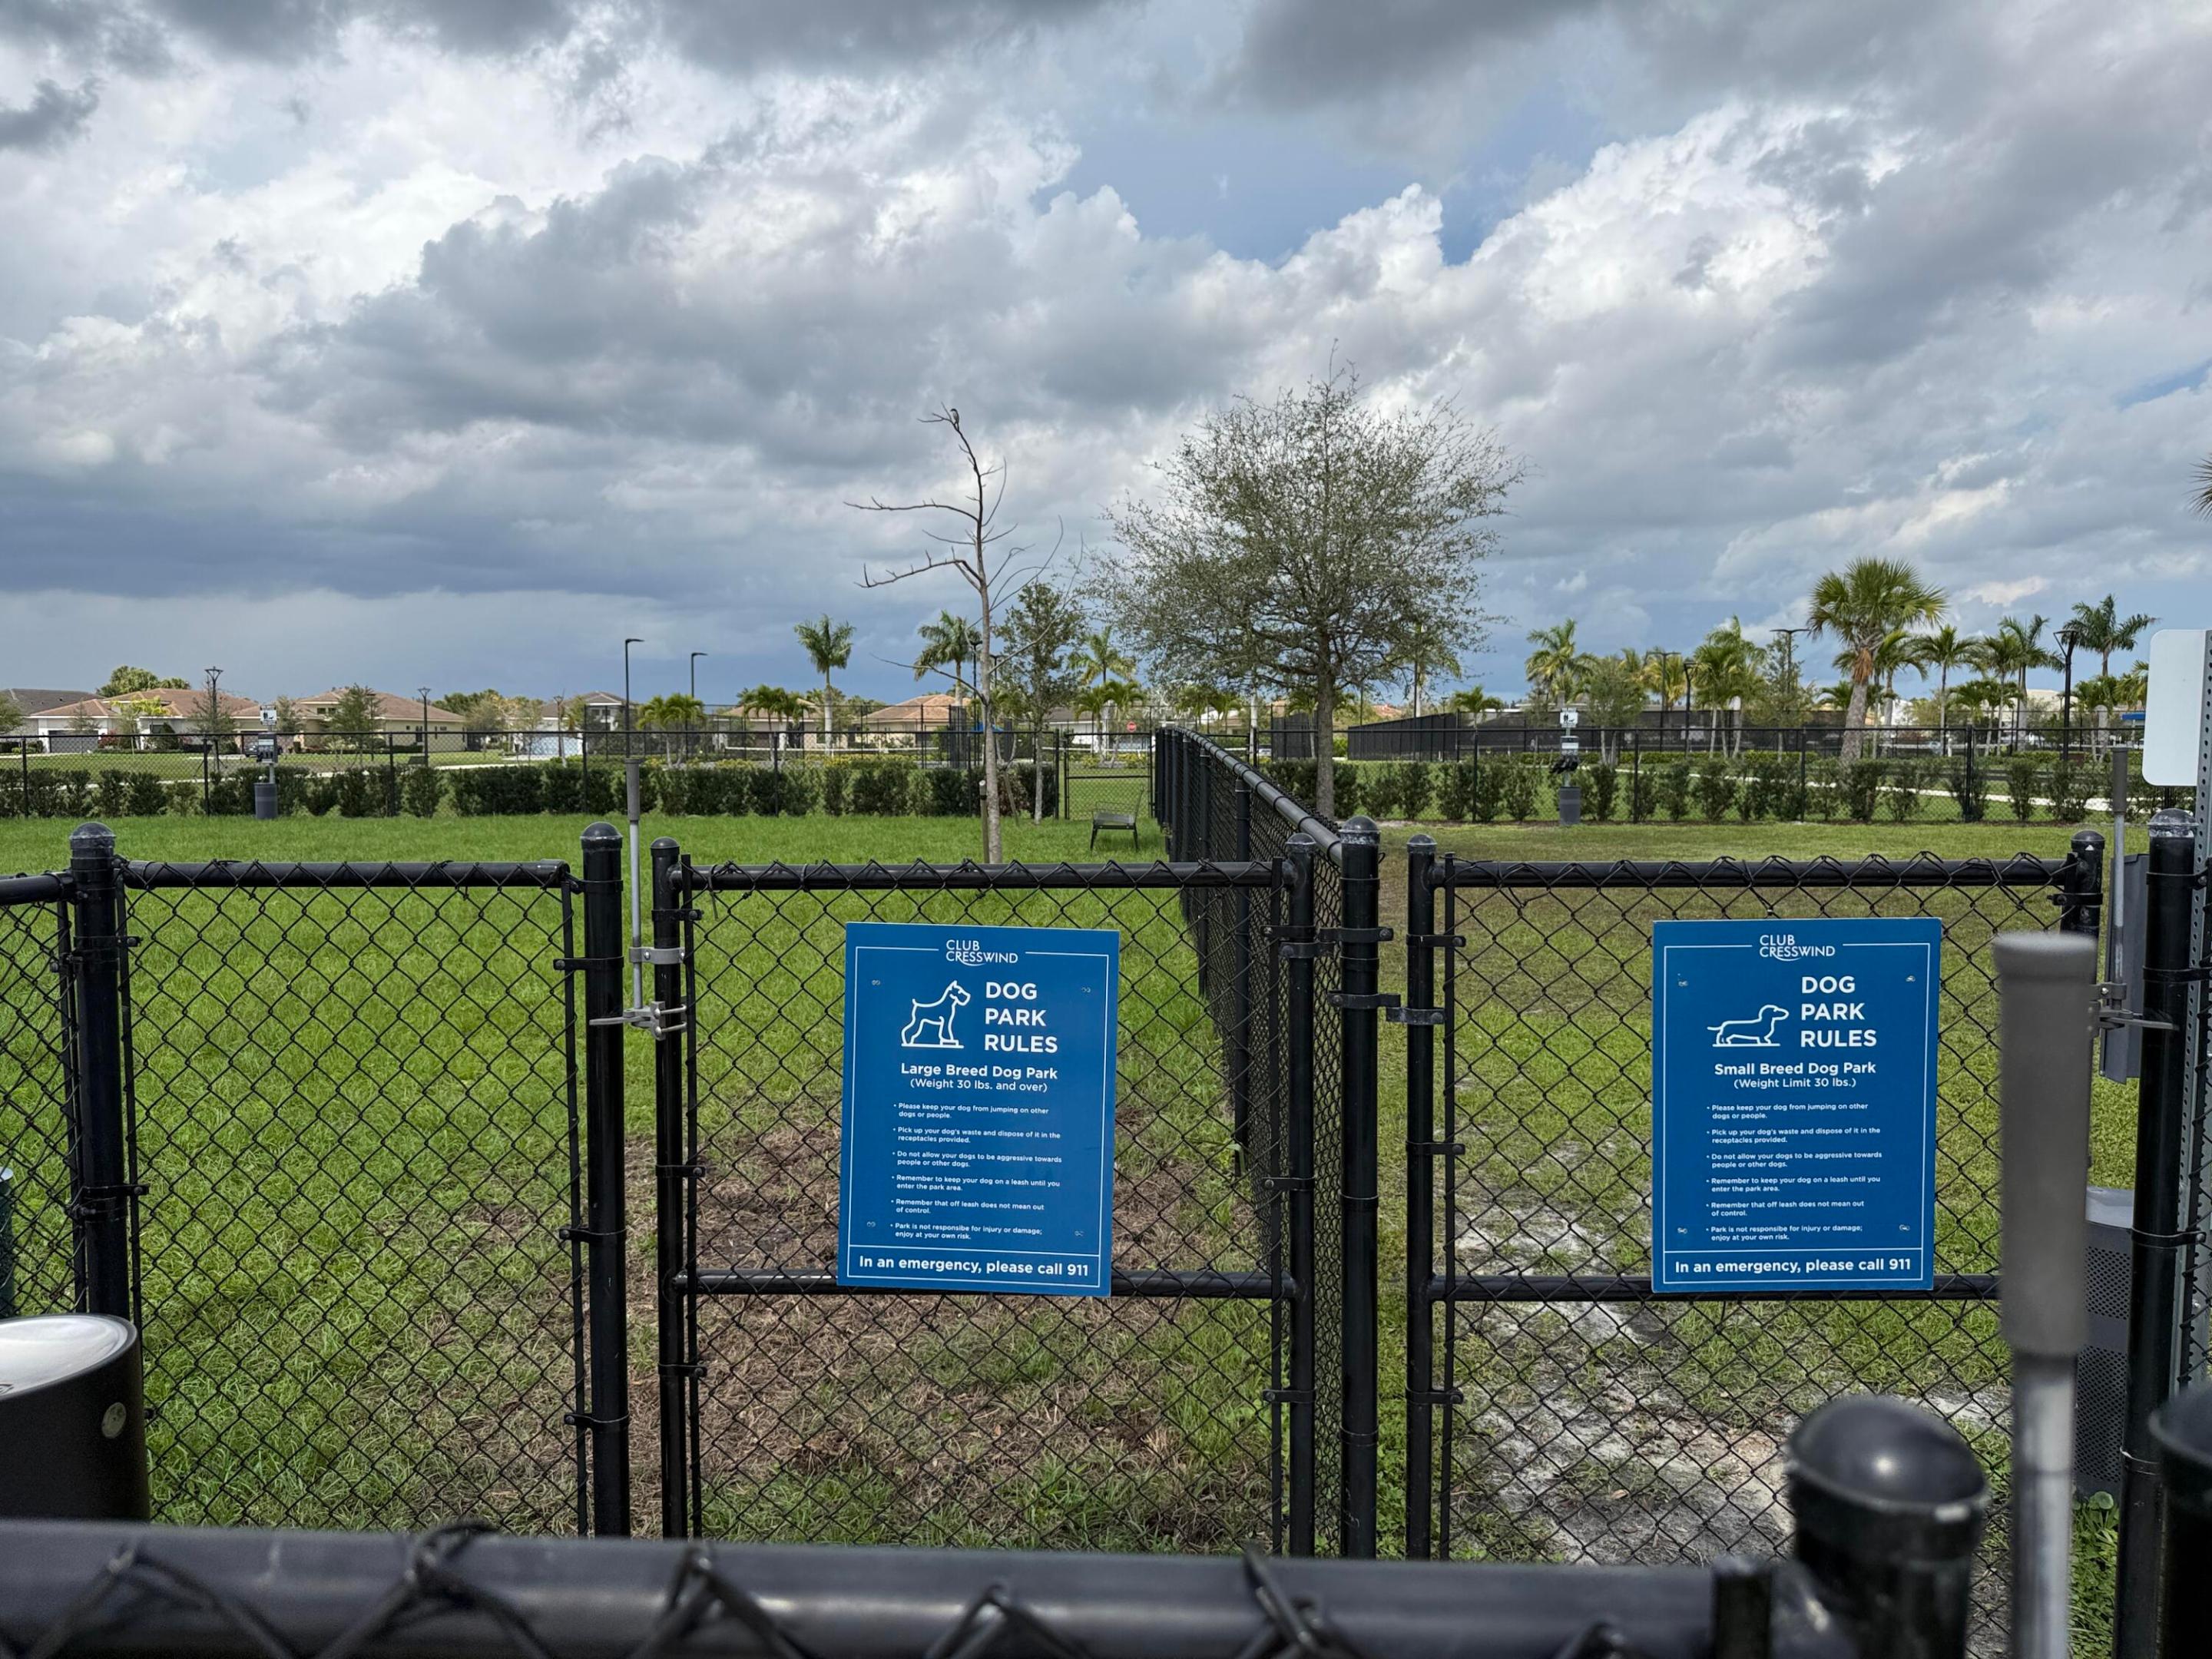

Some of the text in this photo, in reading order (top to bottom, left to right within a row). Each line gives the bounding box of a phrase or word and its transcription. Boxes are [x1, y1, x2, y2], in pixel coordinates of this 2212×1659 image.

[945, 939, 980, 952] CLUB
[1760, 934, 1796, 946] CLUB
[945, 950, 1018, 965] CRESSWIND
[1760, 945, 1836, 960] CRESSWIND
[985, 982, 1038, 1000] DOG
[1802, 975, 1856, 994] DOG
[985, 1008, 1046, 1027] PARK
[1801, 1003, 1865, 1021] PARK
[985, 1034, 1058, 1053] RULES
[1800, 1029, 1877, 1048] RULES
[901, 1062, 1058, 1080] Large Breed Dog Park
[1714, 1061, 1876, 1076] Small Breed Dog Park
[910, 1078, 1048, 1093] (Weight 30 lbs. and over)
[1734, 1077, 1856, 1090] (Weight Limit 30 lbs.)
[990, 1105, 1018, 1114] jumping
[895, 1230, 914, 1239] enjoy
[859, 1255, 1088, 1277] In an emergency, please call 911
[1675, 1258, 1911, 1274] In an emergency, please call 911
